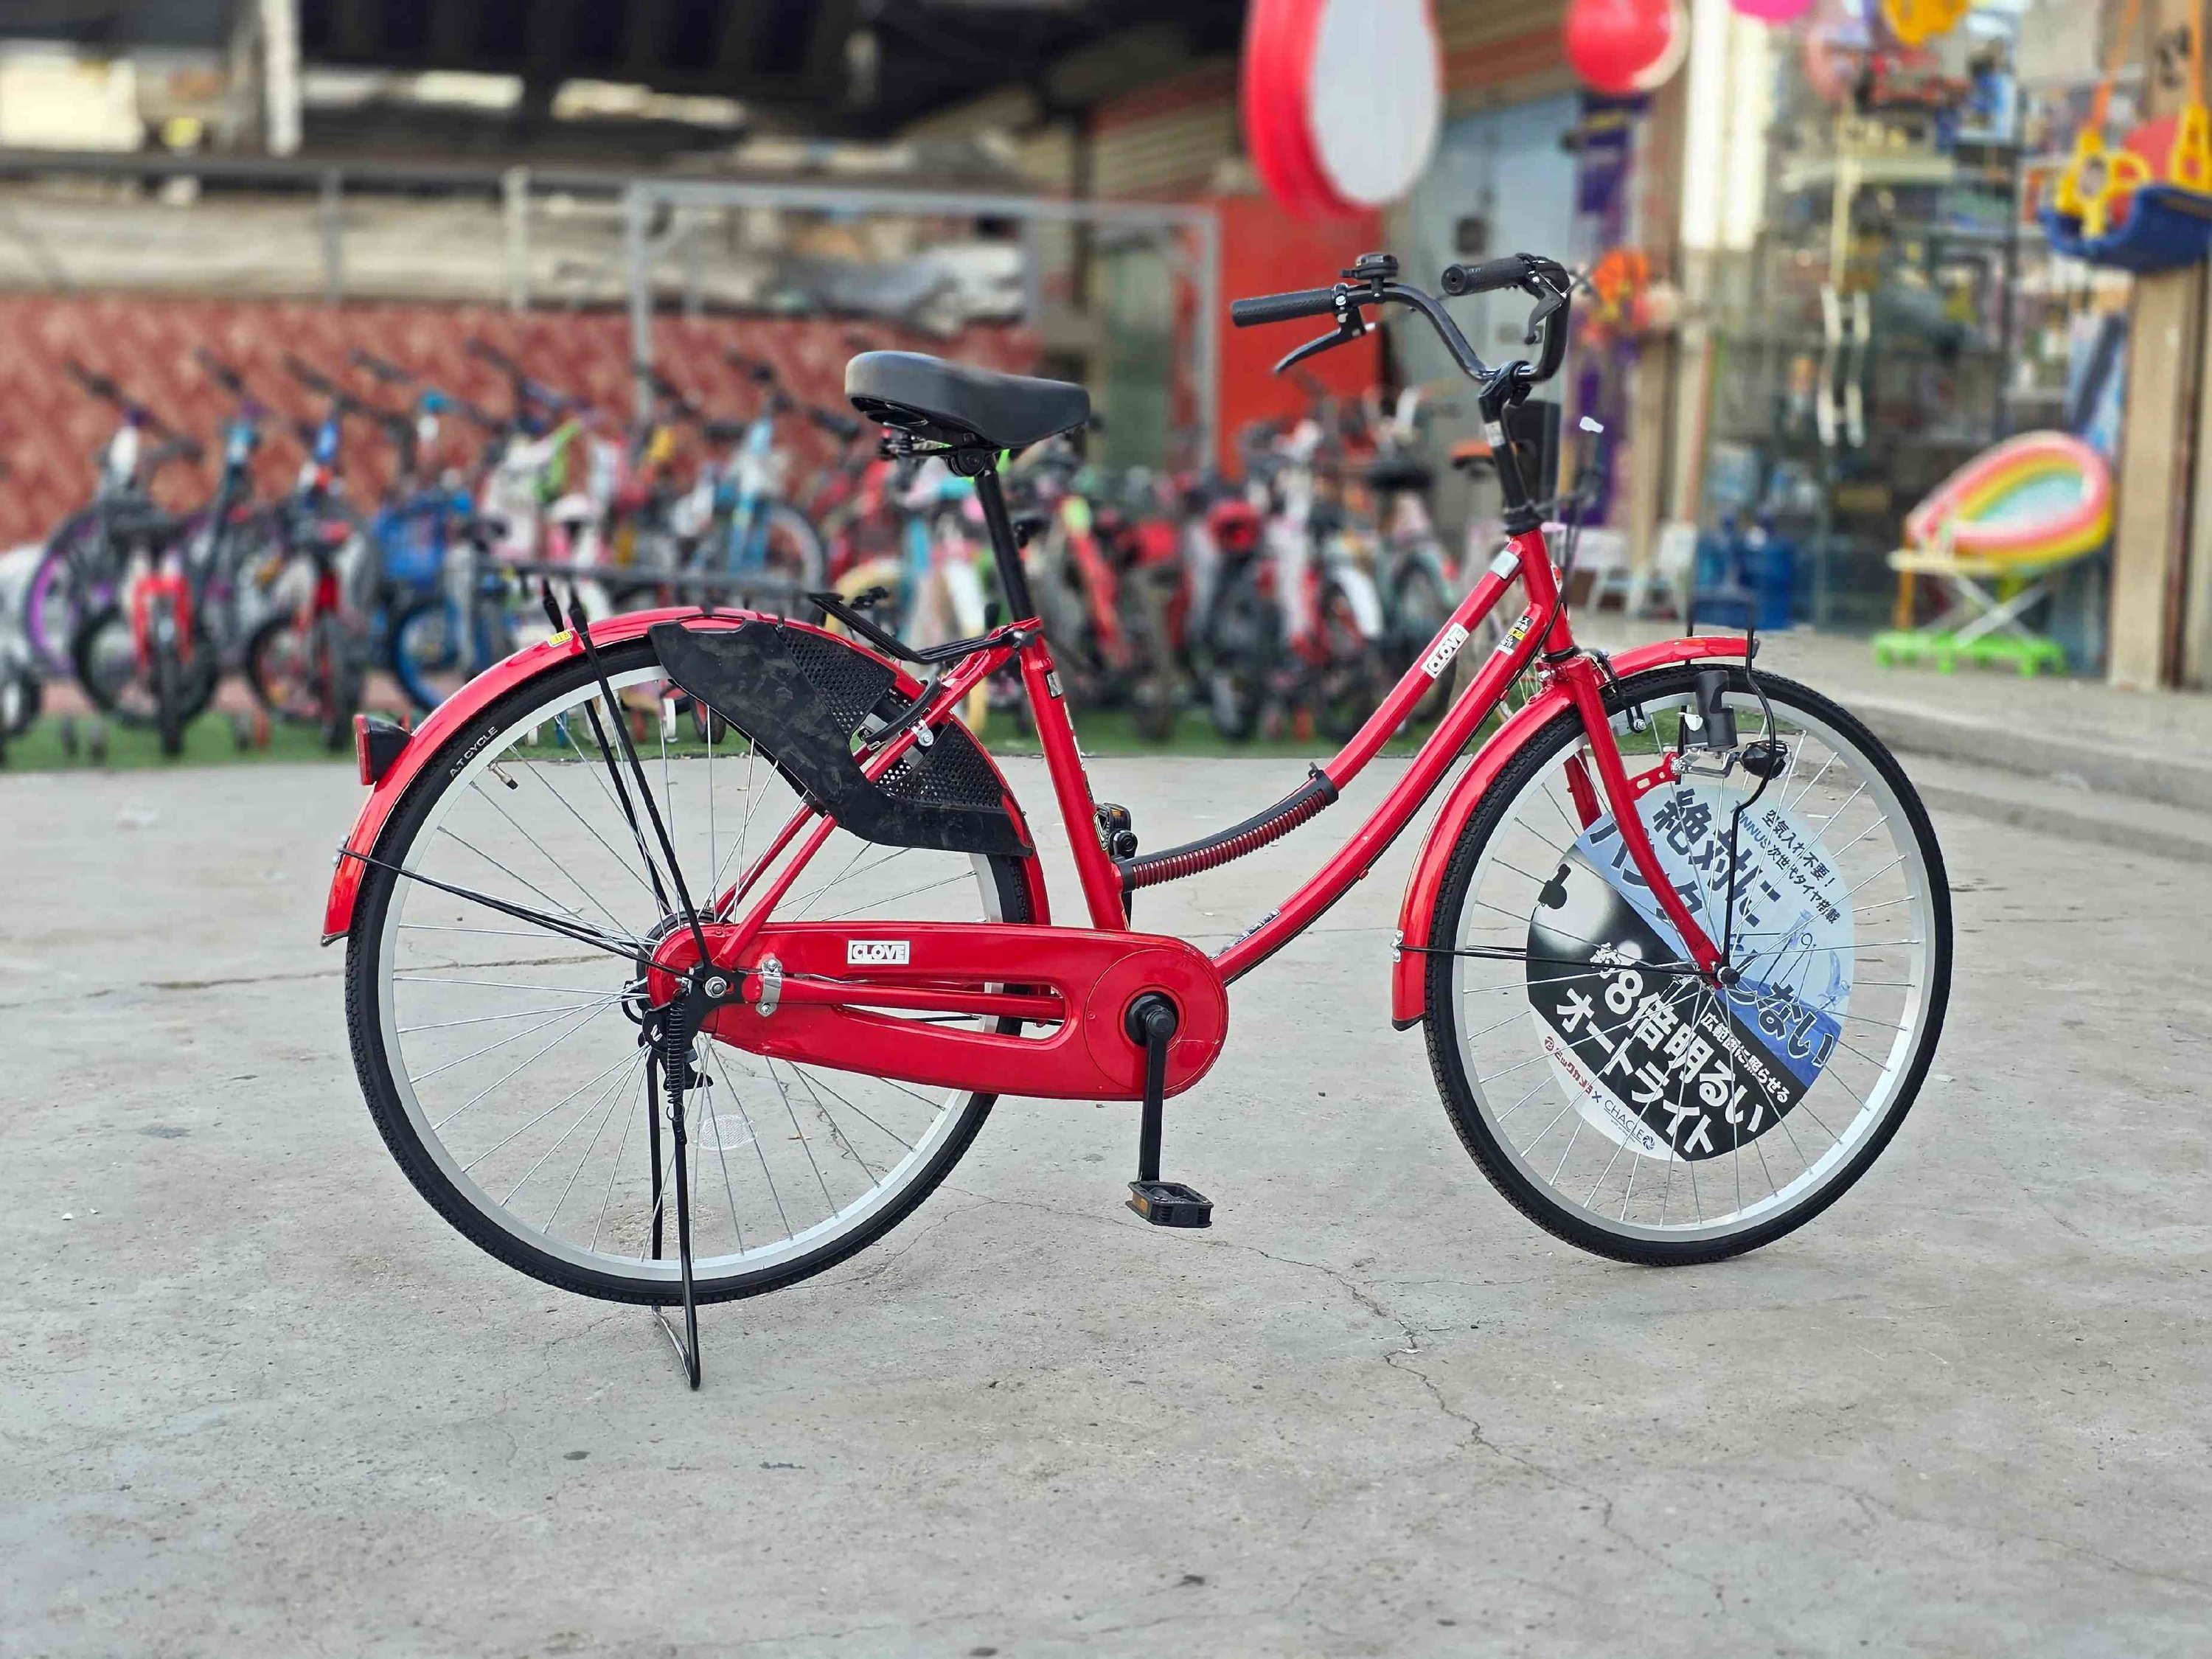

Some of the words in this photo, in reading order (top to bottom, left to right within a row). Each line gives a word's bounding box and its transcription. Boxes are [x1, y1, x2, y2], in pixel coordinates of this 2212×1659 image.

[464, 726, 498, 759] CYCLE
[1652, 787, 1781, 928] 絶対に
[852, 944, 905, 961] CLOVE
[1557, 987, 1714, 1153] オートライト
[1700, 1012, 1791, 1104] 広範囲に照らせる
